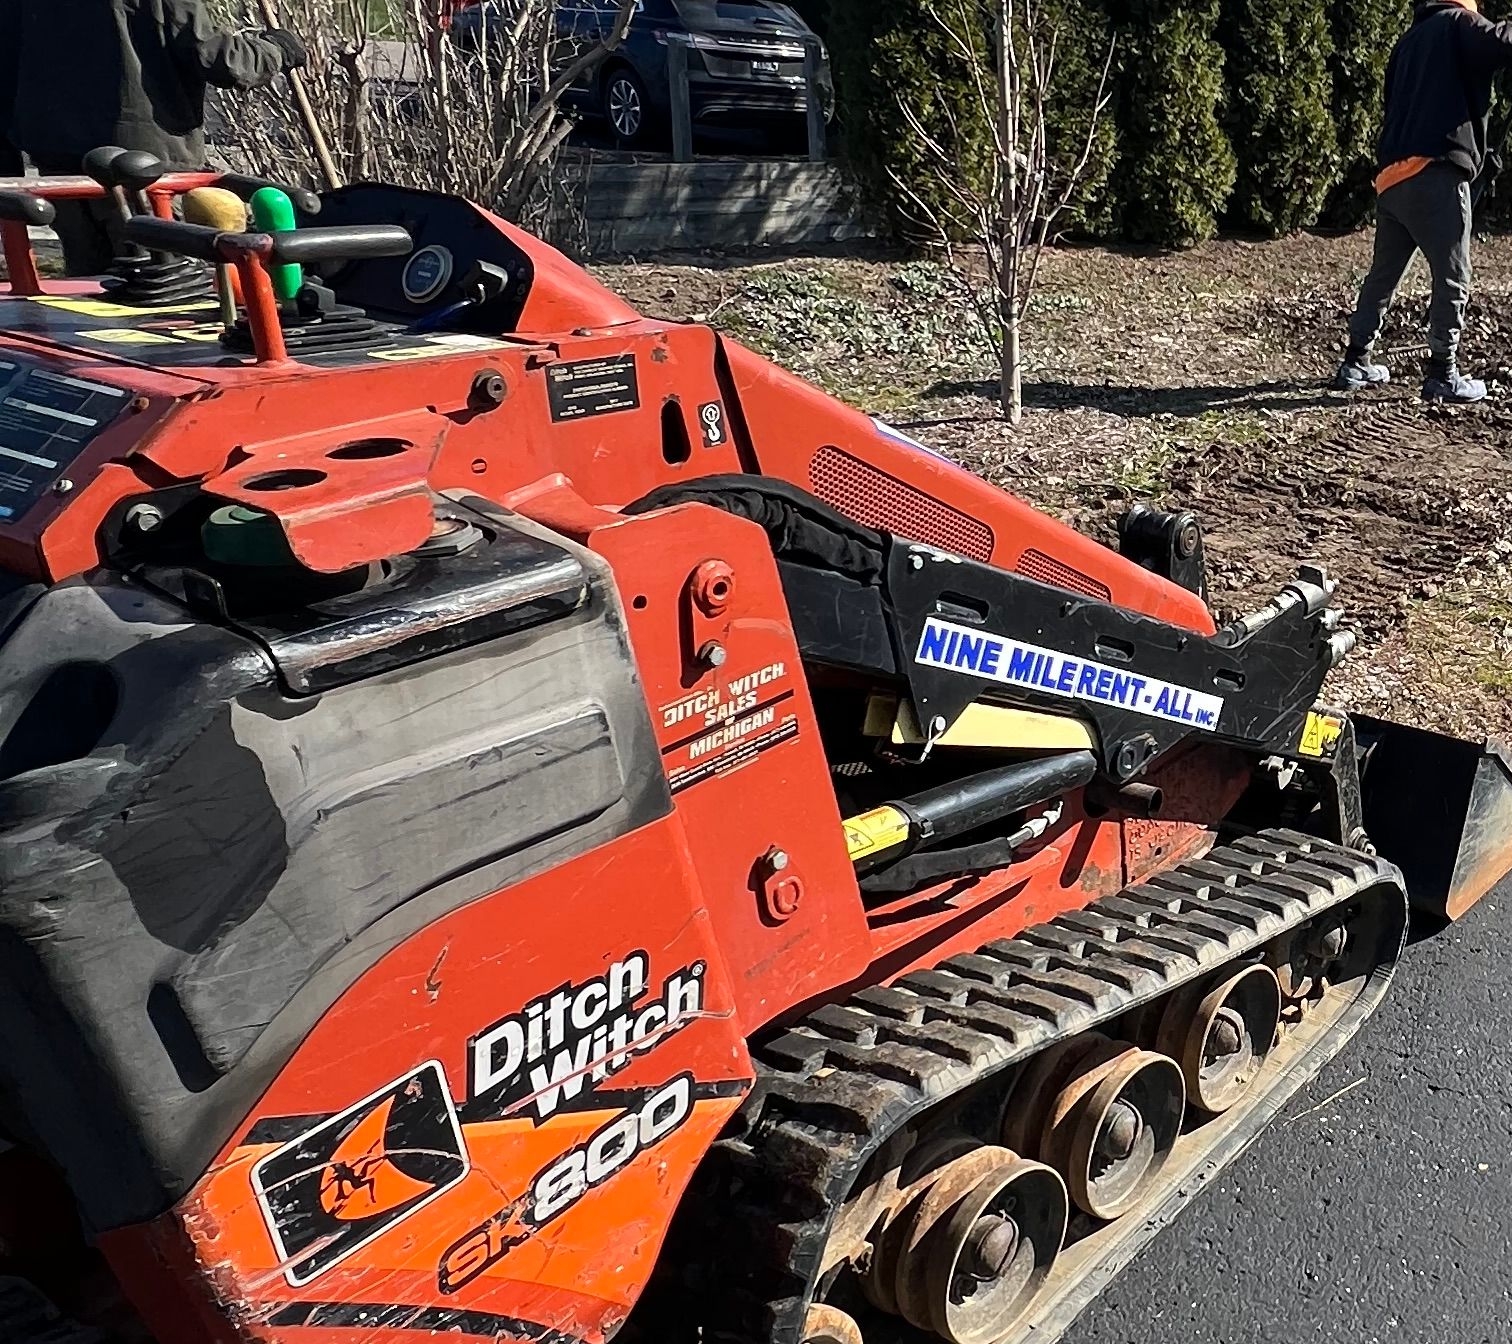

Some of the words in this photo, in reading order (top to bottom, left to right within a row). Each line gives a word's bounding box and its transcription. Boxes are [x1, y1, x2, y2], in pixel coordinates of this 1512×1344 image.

[727, 662, 785, 696] WITCH
[919, 625, 1003, 675] NINE
[1006, 647, 1078, 693] MILE
[689, 706, 775, 760] MICHIGAN
[704, 690, 758, 727] SALES
[474, 955, 644, 1098] Ditch
[529, 974, 701, 1118] Witch
